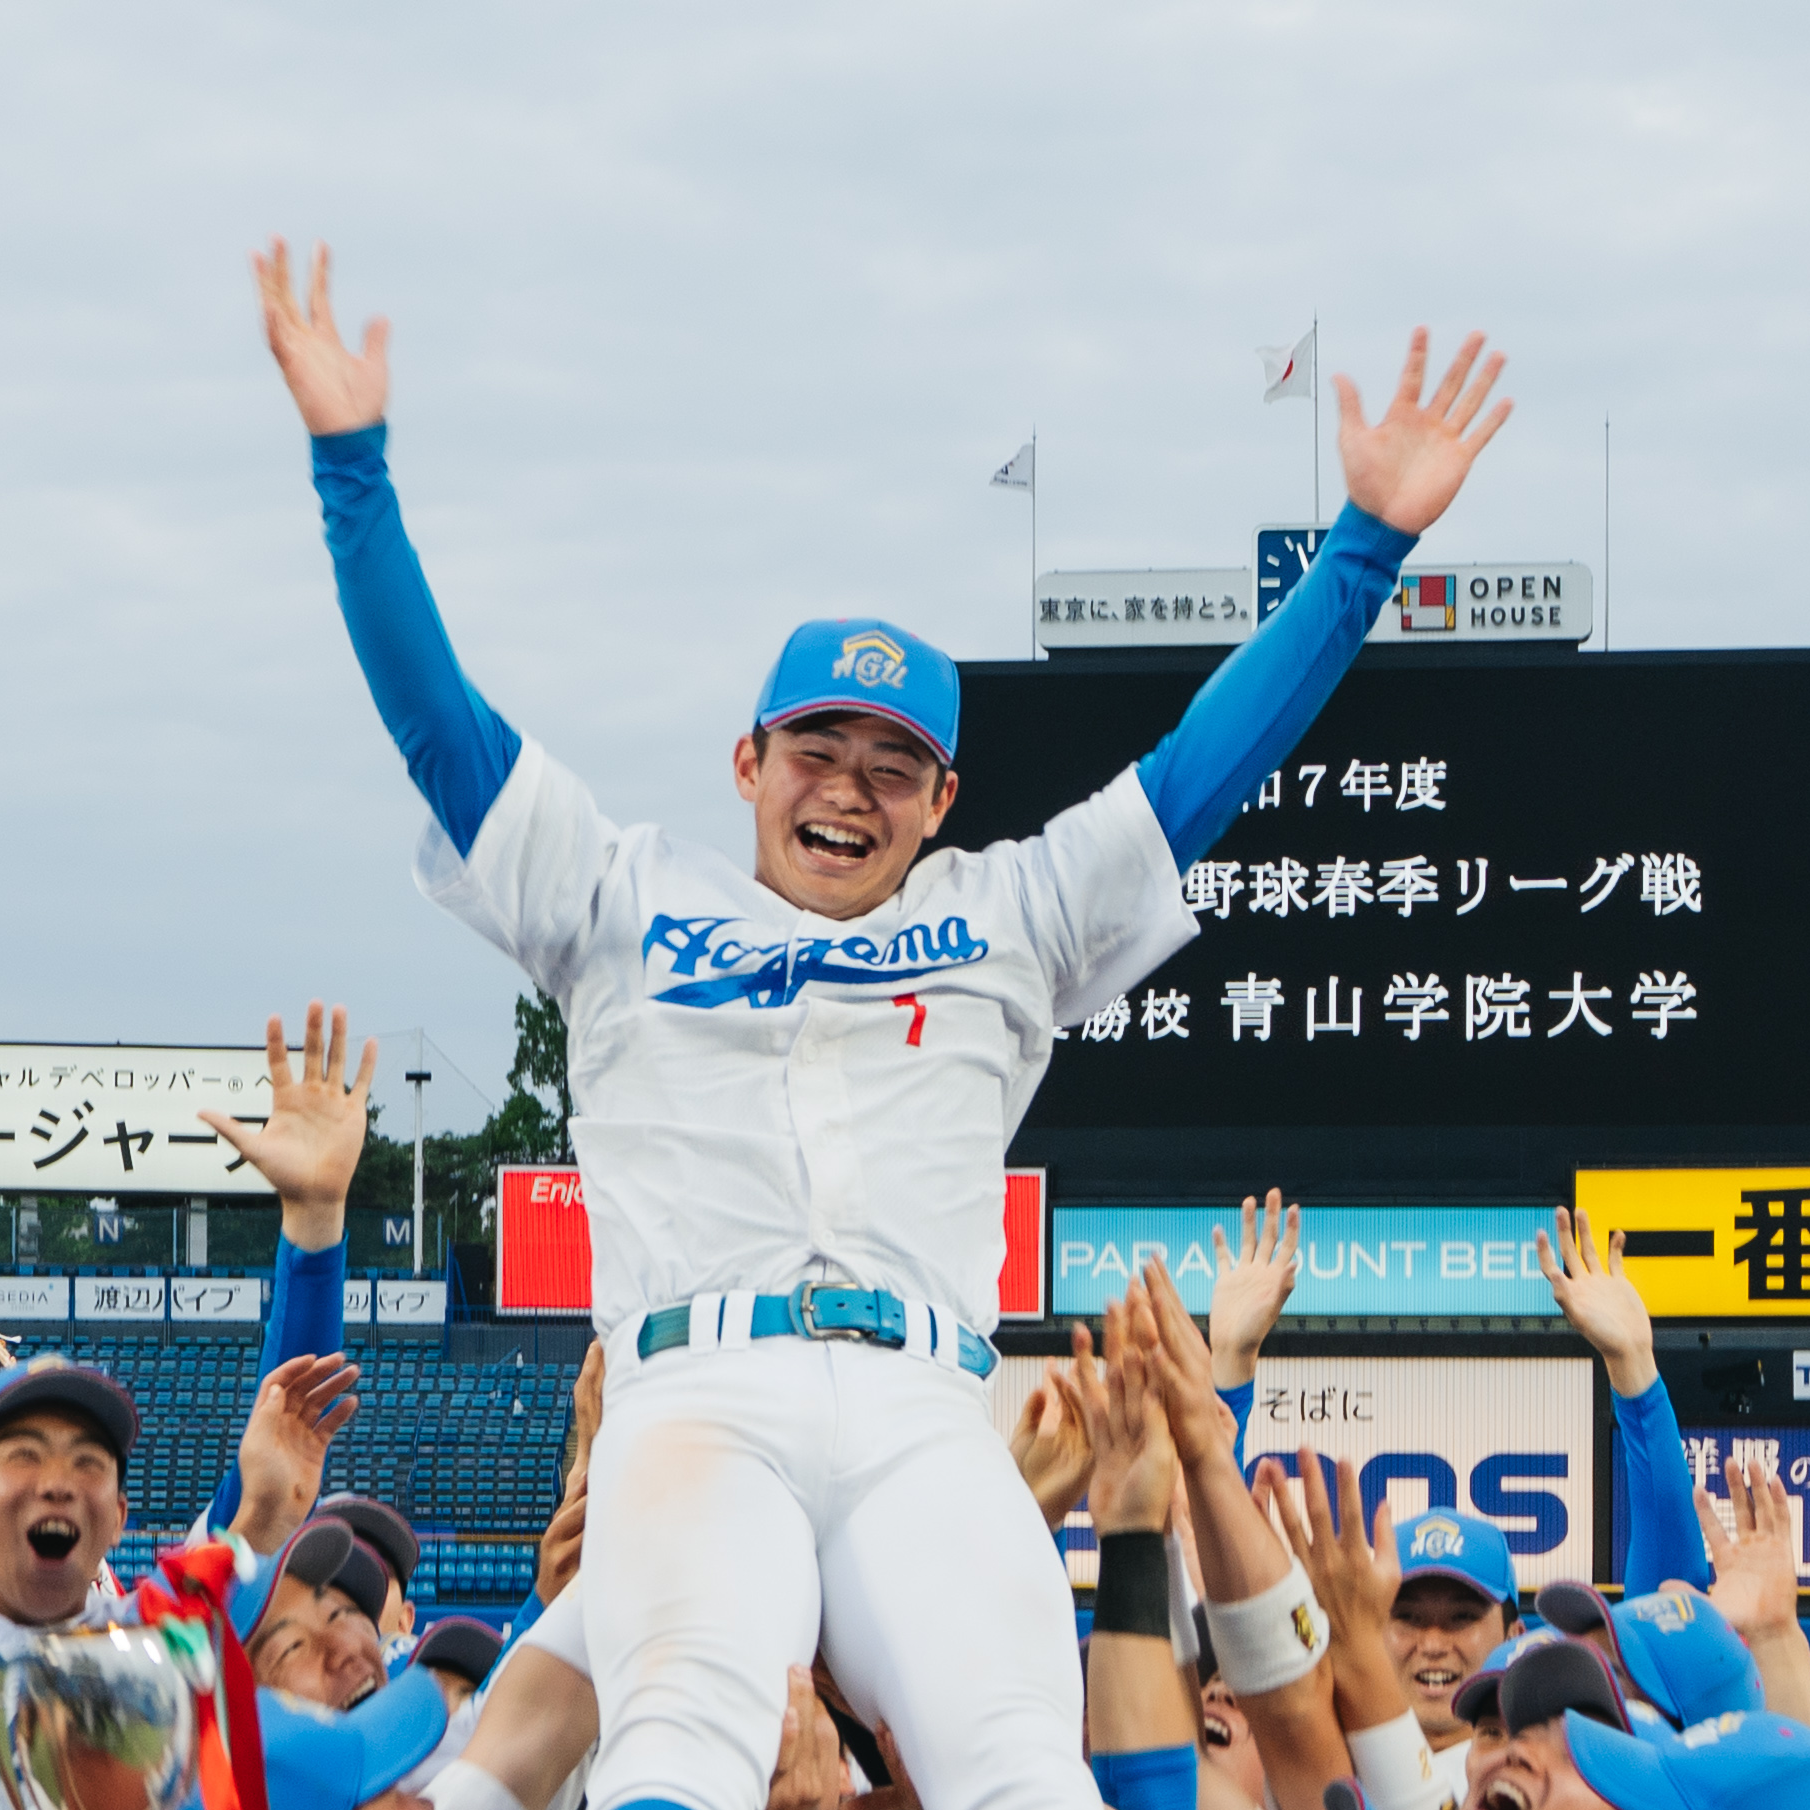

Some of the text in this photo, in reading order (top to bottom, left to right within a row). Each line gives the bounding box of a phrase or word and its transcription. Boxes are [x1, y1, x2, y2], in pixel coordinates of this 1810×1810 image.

[1470, 575, 1562, 600] OPEN
[1039, 595, 1248, 622] 東京に、家を持とう。
[1470, 606, 1562, 626] HOUSE
[1243, 756, 1447, 814] 7年度
[1185, 852, 1702, 919] 野球春季リーグ戦
[892, 993, 928, 1046] 7
[1052, 970, 1698, 1042] 勝校 青山学院大学
[530, 1175, 586, 1208] Enj
[98, 1216, 120, 1242] N
[385, 1217, 411, 1244] M
[1440, 1242, 1558, 1279] BED
[344, 1290, 430, 1313] 辺パイプ
[1260, 1387, 1375, 1424] そばに
